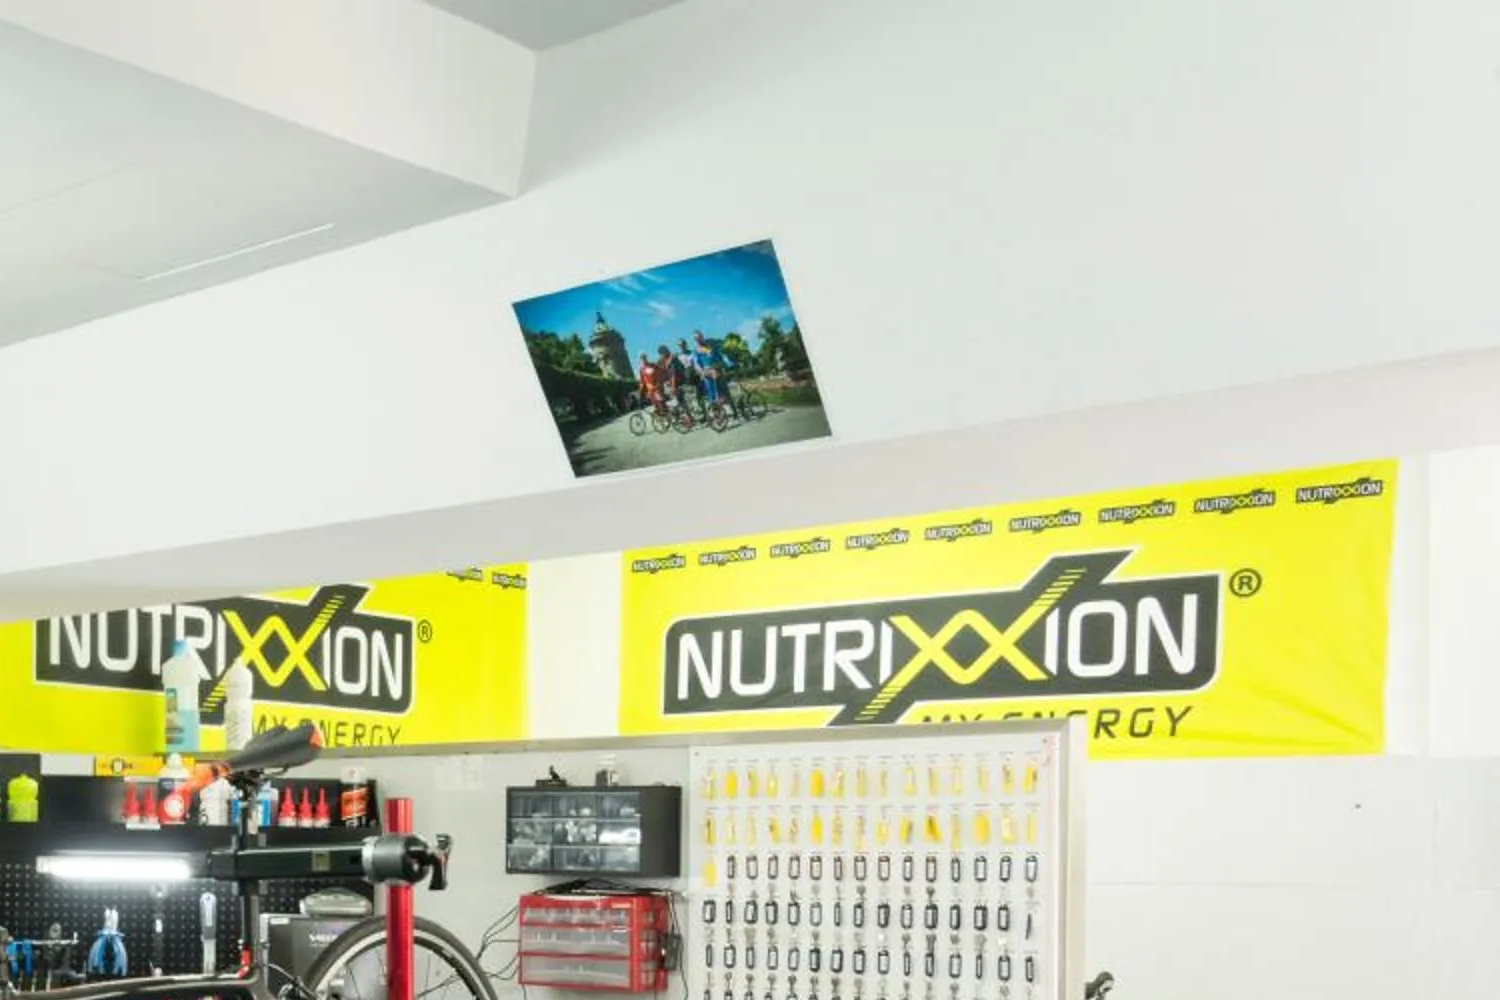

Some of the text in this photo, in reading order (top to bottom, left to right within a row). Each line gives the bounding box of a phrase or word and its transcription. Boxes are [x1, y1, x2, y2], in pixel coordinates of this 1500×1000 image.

[50, 597, 405, 710] NUTRIXXION
[677, 572, 1199, 716] NUTRIXXION
[299, 717, 402, 748] NERGY
